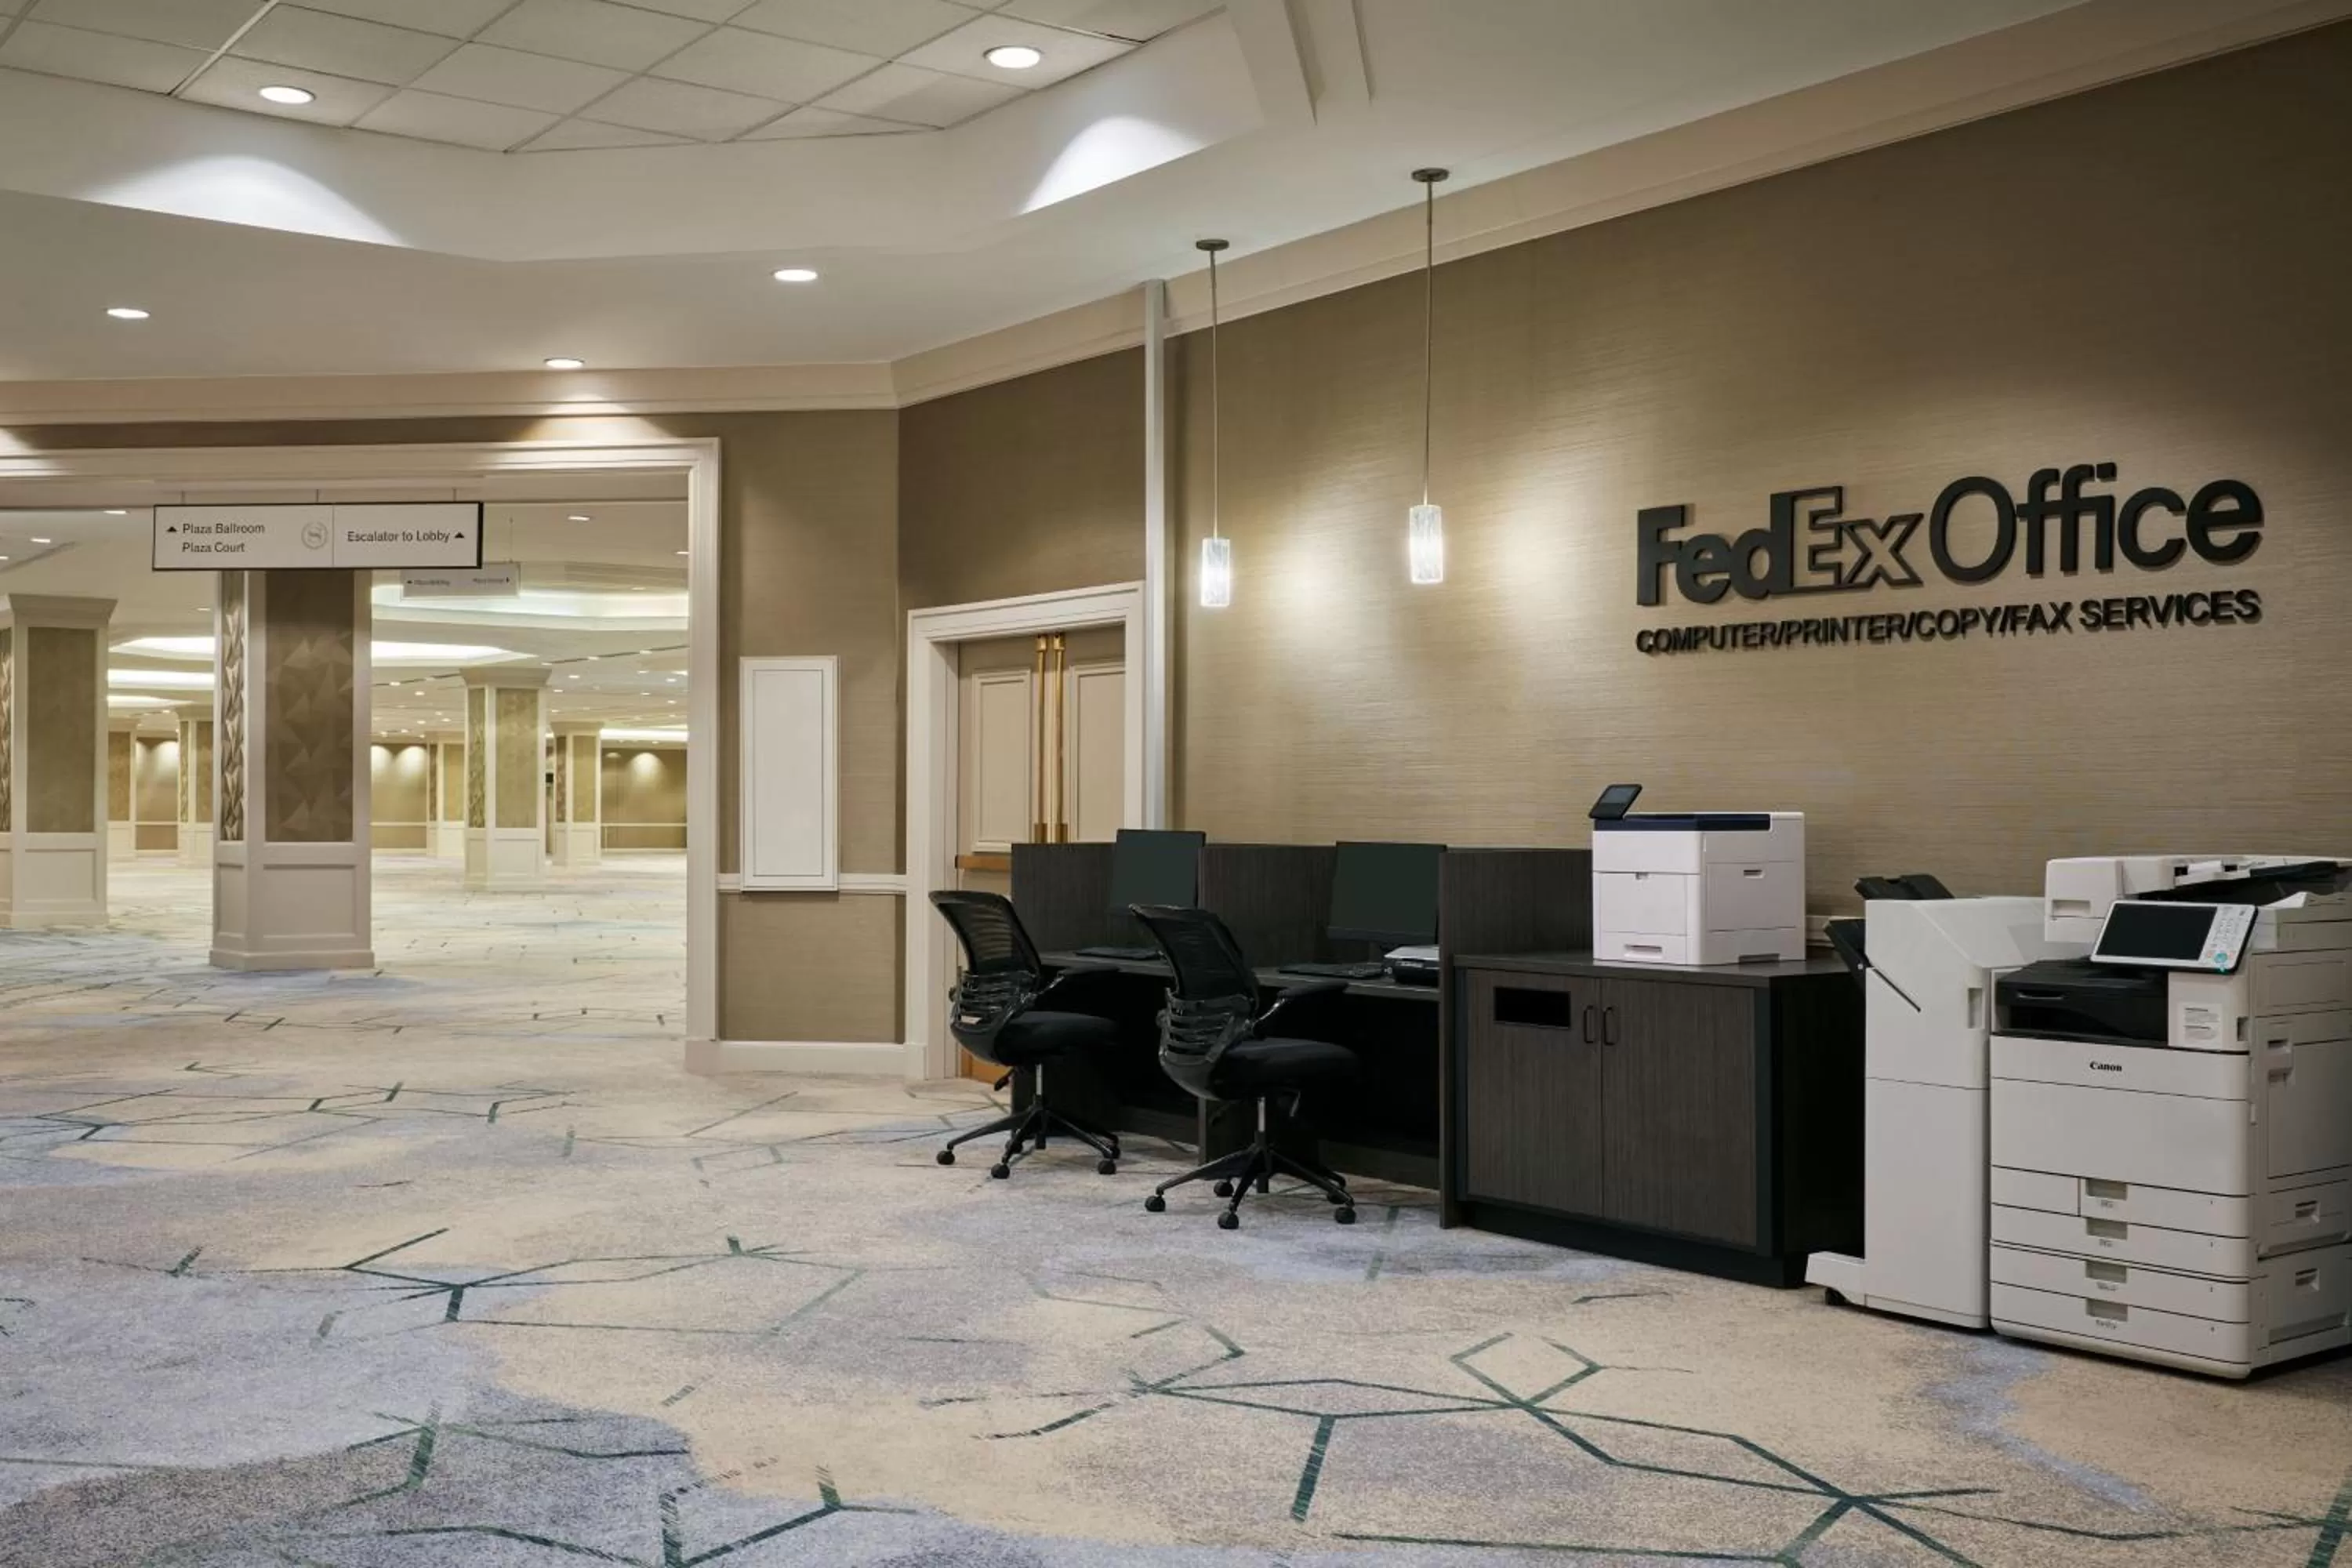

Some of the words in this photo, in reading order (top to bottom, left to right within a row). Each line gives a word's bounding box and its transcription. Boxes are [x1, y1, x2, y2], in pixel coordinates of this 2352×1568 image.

[182, 522, 212, 534] Plaza
[216, 523, 265, 534] Ballroom
[347, 531, 398, 543] Escalator
[401, 531, 413, 542] to
[416, 530, 450, 544] Lobby
[182, 542, 212, 553] Plaza
[214, 543, 245, 553] Court
[2079, 590, 2262, 630] SERVICES
[2089, 1062, 2122, 1072] Canon
